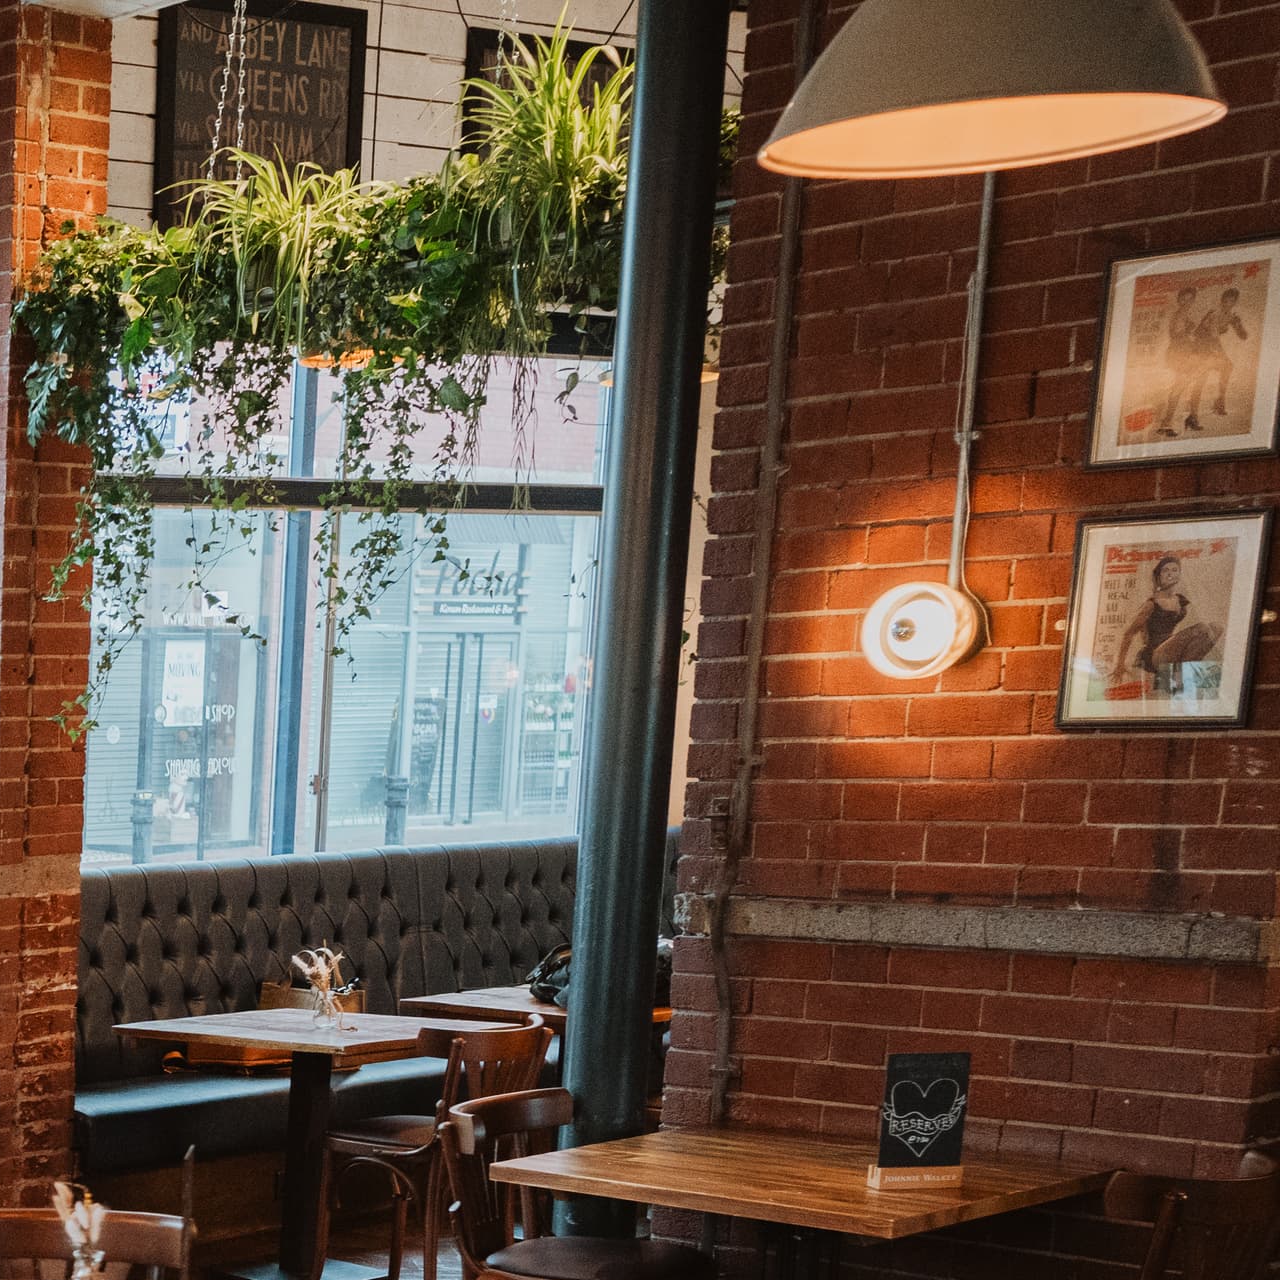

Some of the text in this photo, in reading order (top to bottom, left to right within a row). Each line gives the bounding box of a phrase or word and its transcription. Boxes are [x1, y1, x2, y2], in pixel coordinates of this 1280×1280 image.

[180, 23, 213, 44] AND
[295, 23, 349, 72] LANE
[179, 71, 205, 93] VIA
[209, 66, 310, 115] QUEENS
[211, 704, 236, 723] SHOP
[893, 1115, 956, 1132] RESERVED
